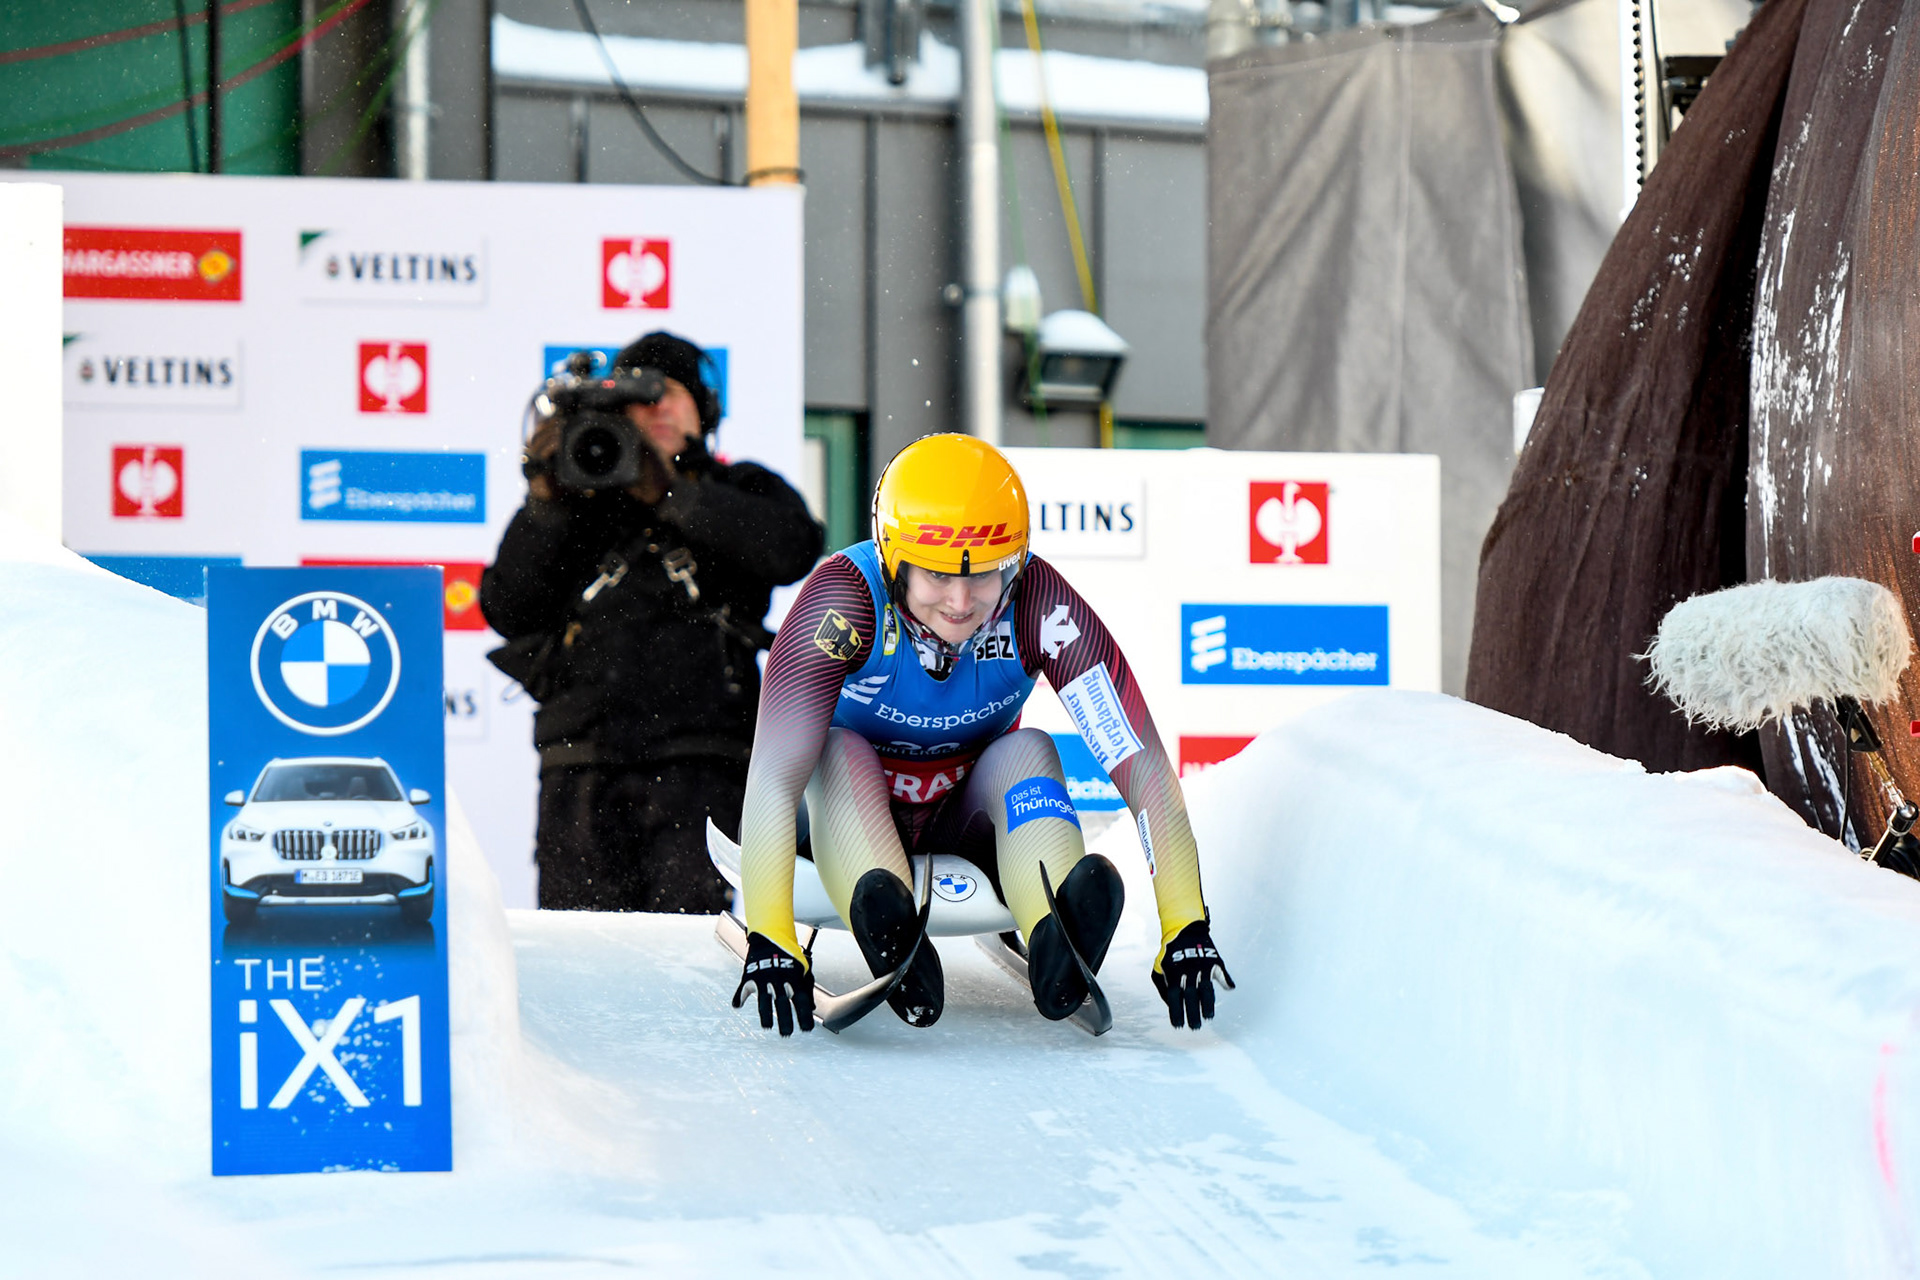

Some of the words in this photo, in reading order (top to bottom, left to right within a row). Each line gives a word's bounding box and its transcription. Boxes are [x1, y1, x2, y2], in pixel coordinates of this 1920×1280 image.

[349, 252, 477, 281] VELTINS
[103, 356, 232, 386] VELTINS
[1041, 502, 1134, 532] LTINS
[916, 522, 1012, 548] DHL
[998, 550, 1022, 571] uvex
[271, 600, 381, 640] BMW
[1231, 647, 1380, 675] Eberspächer
[874, 689, 1021, 731] Eberspächer
[1082, 670, 1129, 760] Verglasung
[1066, 692, 1109, 765] Bussemer
[1011, 788, 1029, 805] Das
[1029, 785, 1042, 796] ist
[234, 958, 324, 991] THE
[238, 994, 422, 1109] iX1
